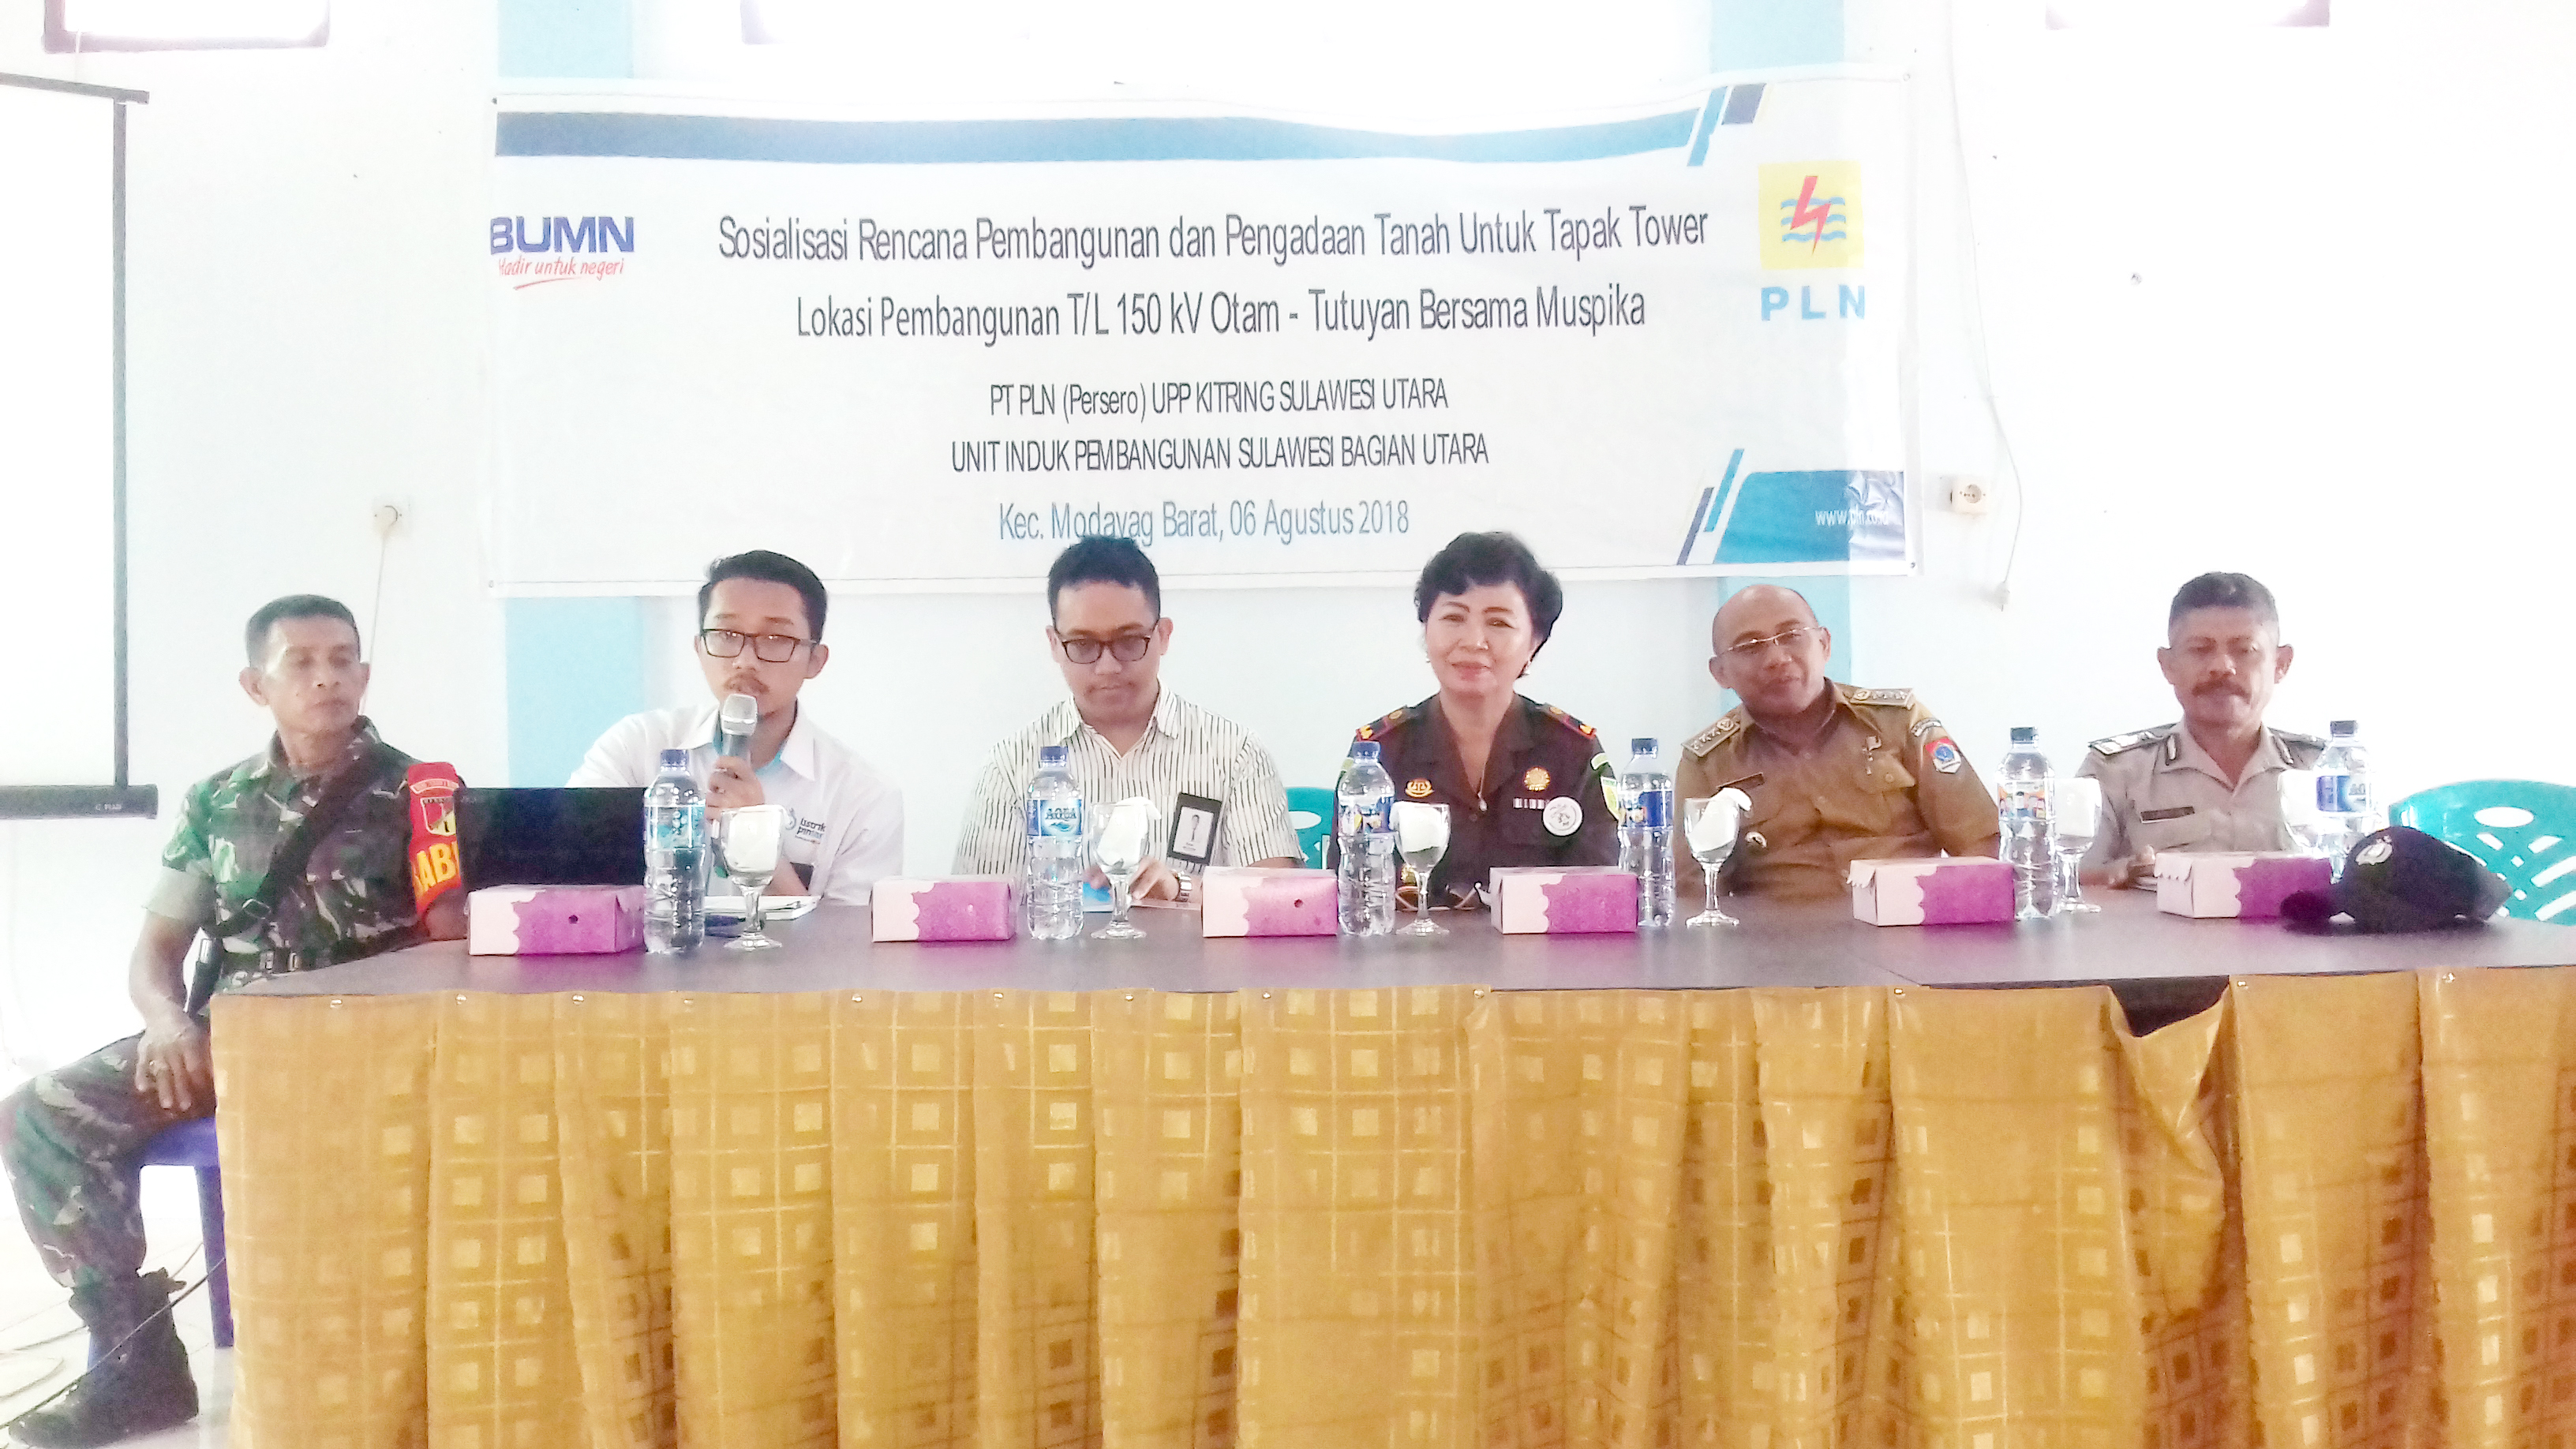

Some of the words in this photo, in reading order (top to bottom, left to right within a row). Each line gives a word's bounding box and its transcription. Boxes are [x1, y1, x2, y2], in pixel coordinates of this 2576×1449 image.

[491, 215, 635, 254] BUMN
[719, 215, 848, 261] Sosialisasi
[859, 219, 968, 260] Rencana
[976, 216, 1159, 270] Pembangunan
[1170, 215, 1215, 258] dan
[1226, 214, 1365, 267] Pengadaan
[1374, 212, 1450, 256] Tanah
[1459, 209, 1537, 254] Untuk
[1544, 205, 1623, 262] Tapak
[1629, 204, 1709, 247] Tower
[534, 256, 576, 275] untuk
[580, 257, 624, 281] negeri
[798, 295, 871, 337] Lokasi
[882, 294, 1059, 347] Pembangunan
[1067, 292, 1109, 335] T/L
[1118, 292, 1161, 335] 150
[1171, 292, 1203, 334] kV
[1211, 291, 1279, 334] Otam
[1309, 289, 1410, 342] Tutuyan
[1420, 288, 1528, 330] Bersama
[1537, 283, 1645, 337] Muspika
[1761, 284, 1865, 321] PLN
[991, 384, 1014, 415] PT
[1020, 384, 1054, 415] PLN
[1064, 382, 1145, 424] (Persero)
[1152, 382, 1191, 414] UPP
[1196, 381, 1274, 413] KITRING
[1280, 378, 1375, 412] SULAWESI
[1383, 378, 1449, 410] UTARA
[952, 440, 1000, 473] UNIT
[1006, 440, 1070, 472] INDUK
[1076, 437, 1230, 471] PEMBANGUNAN
[1238, 436, 1334, 469] SULAWESI
[1342, 434, 1415, 467] BAGIAN
[1424, 432, 1489, 465] UTARA
[1000, 503, 1043, 540] Kec.
[1163, 501, 1223, 542] Barat,
[1230, 500, 1256, 536] 06
[1264, 499, 1354, 545] Agustus
[1359, 500, 1409, 534] 2018
